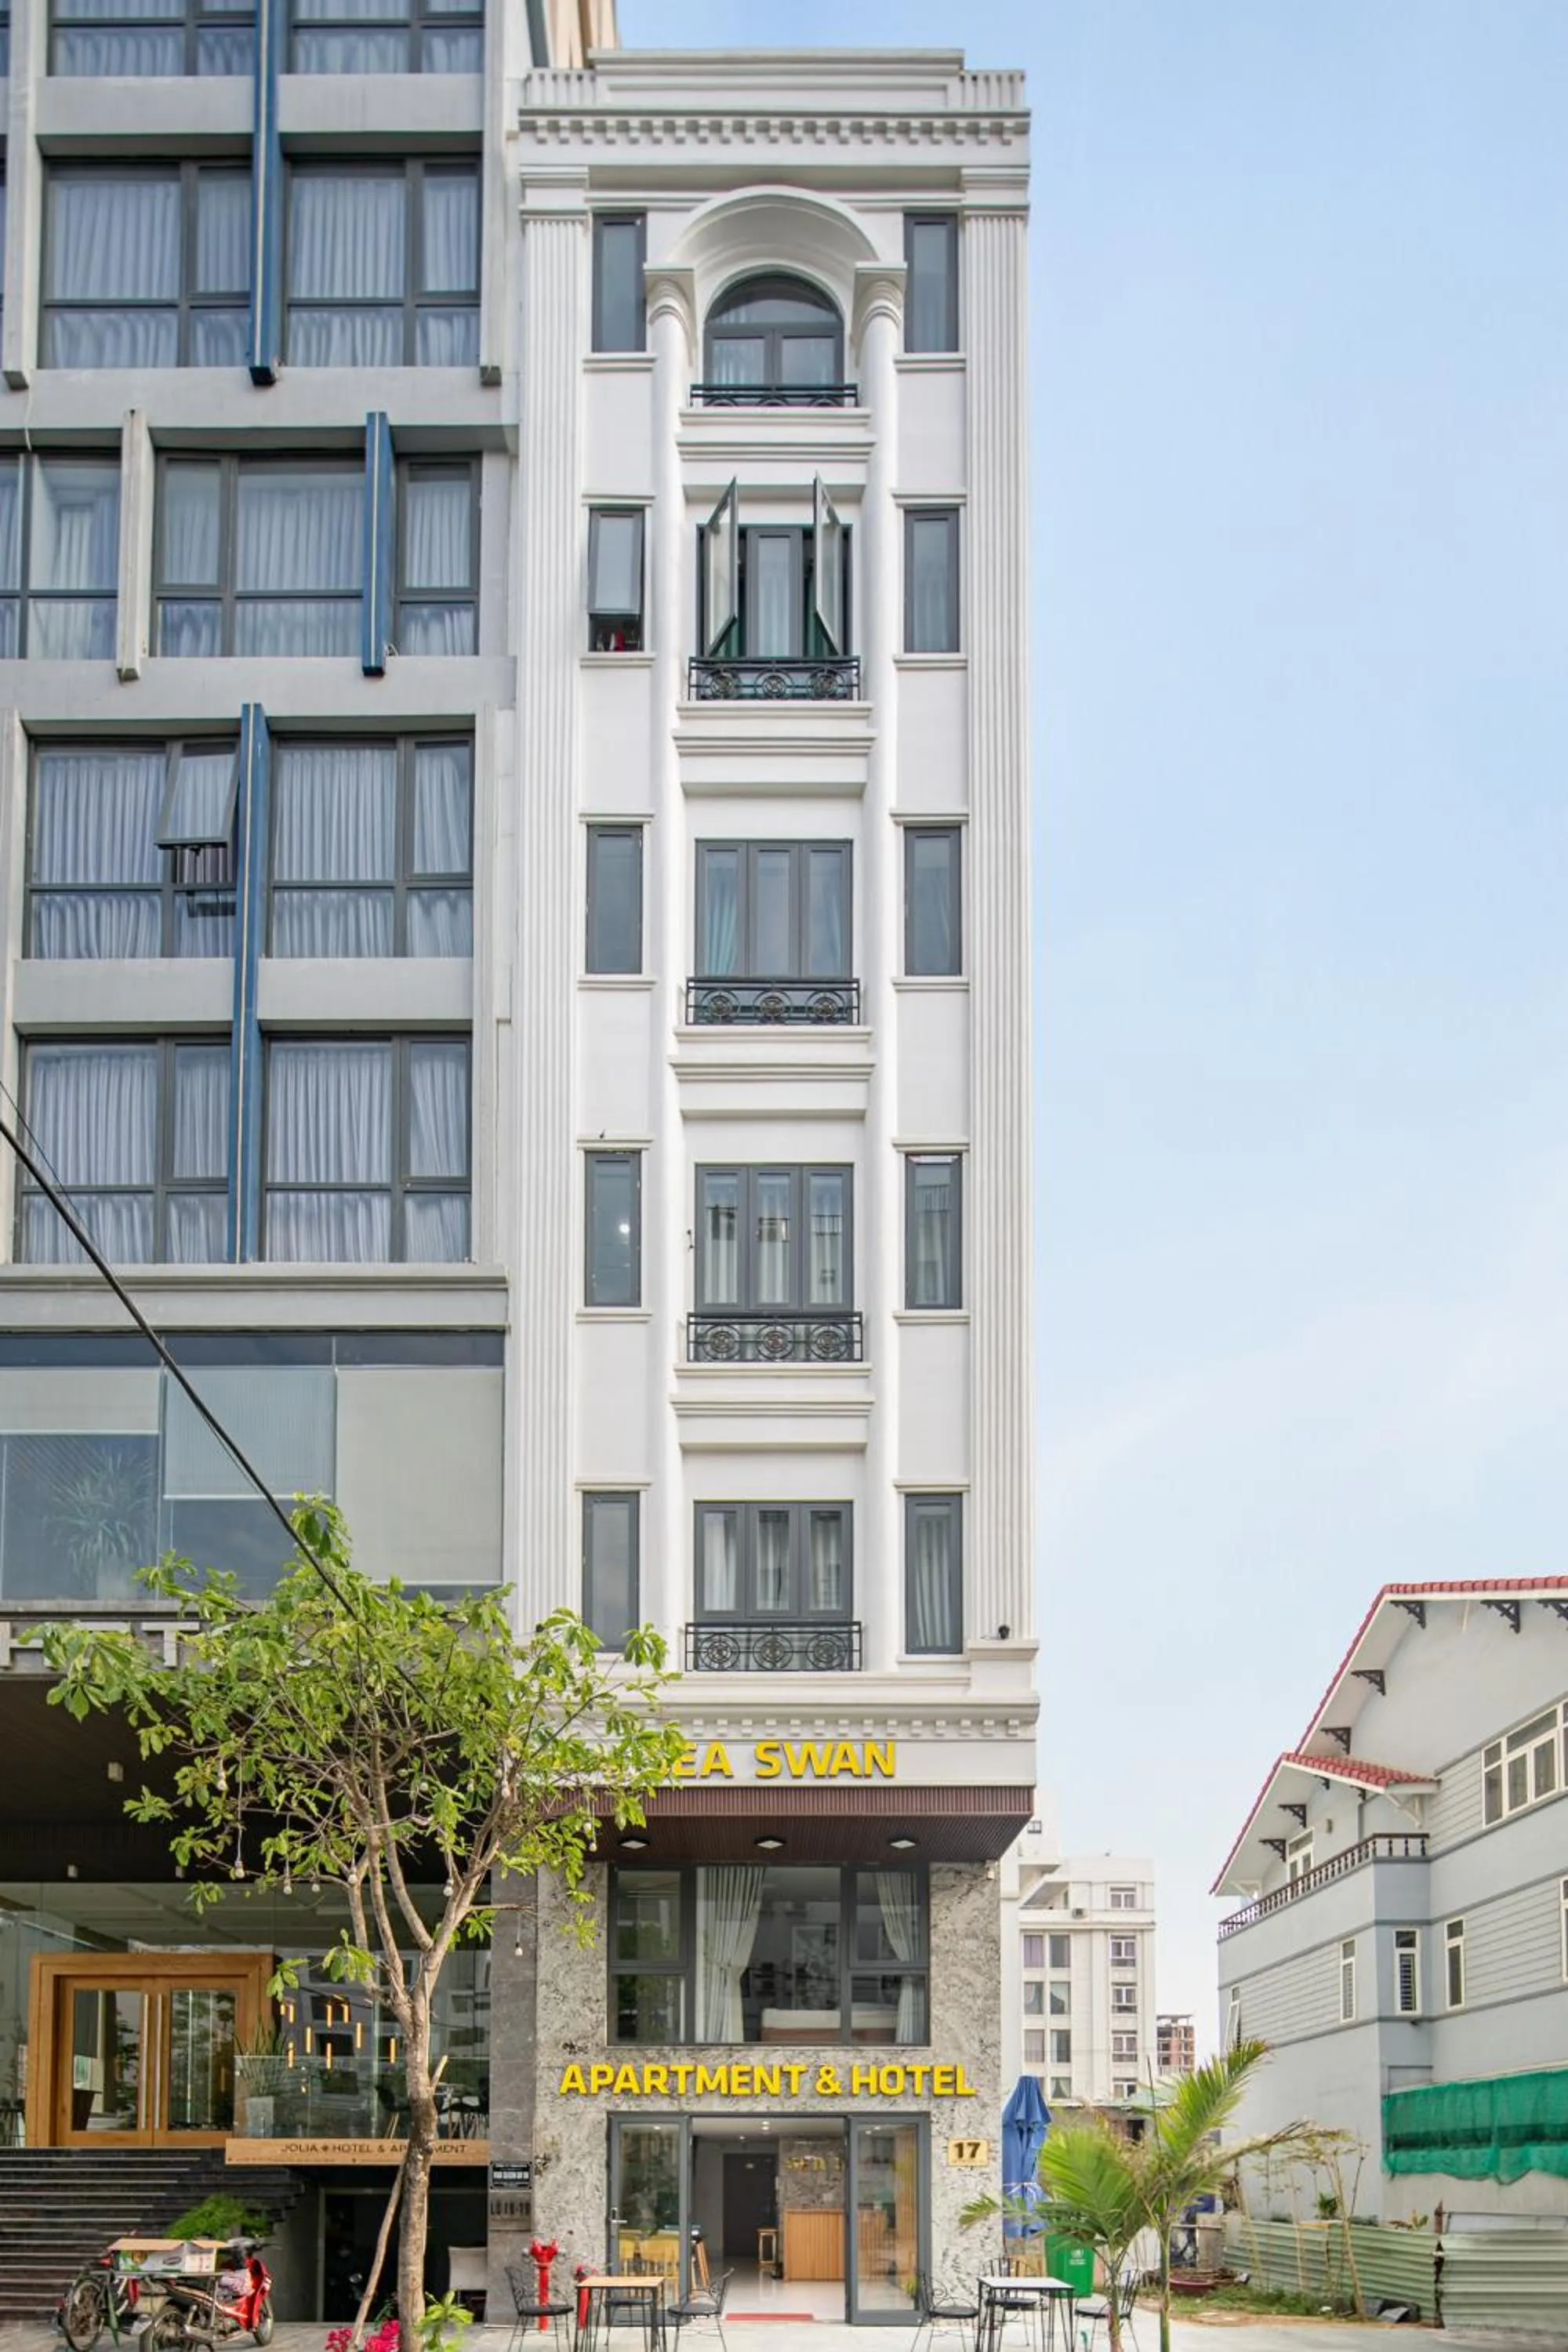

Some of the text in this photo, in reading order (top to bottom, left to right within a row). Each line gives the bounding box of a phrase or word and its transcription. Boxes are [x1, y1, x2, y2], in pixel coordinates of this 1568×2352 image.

[660, 1740, 895, 1778] EA SWAN
[559, 2063, 978, 2096] APARTMENT & HOTEL
[281, 2143, 467, 2154] JOLIA HOTEL & APMENT
[953, 2142, 981, 2158] 17
